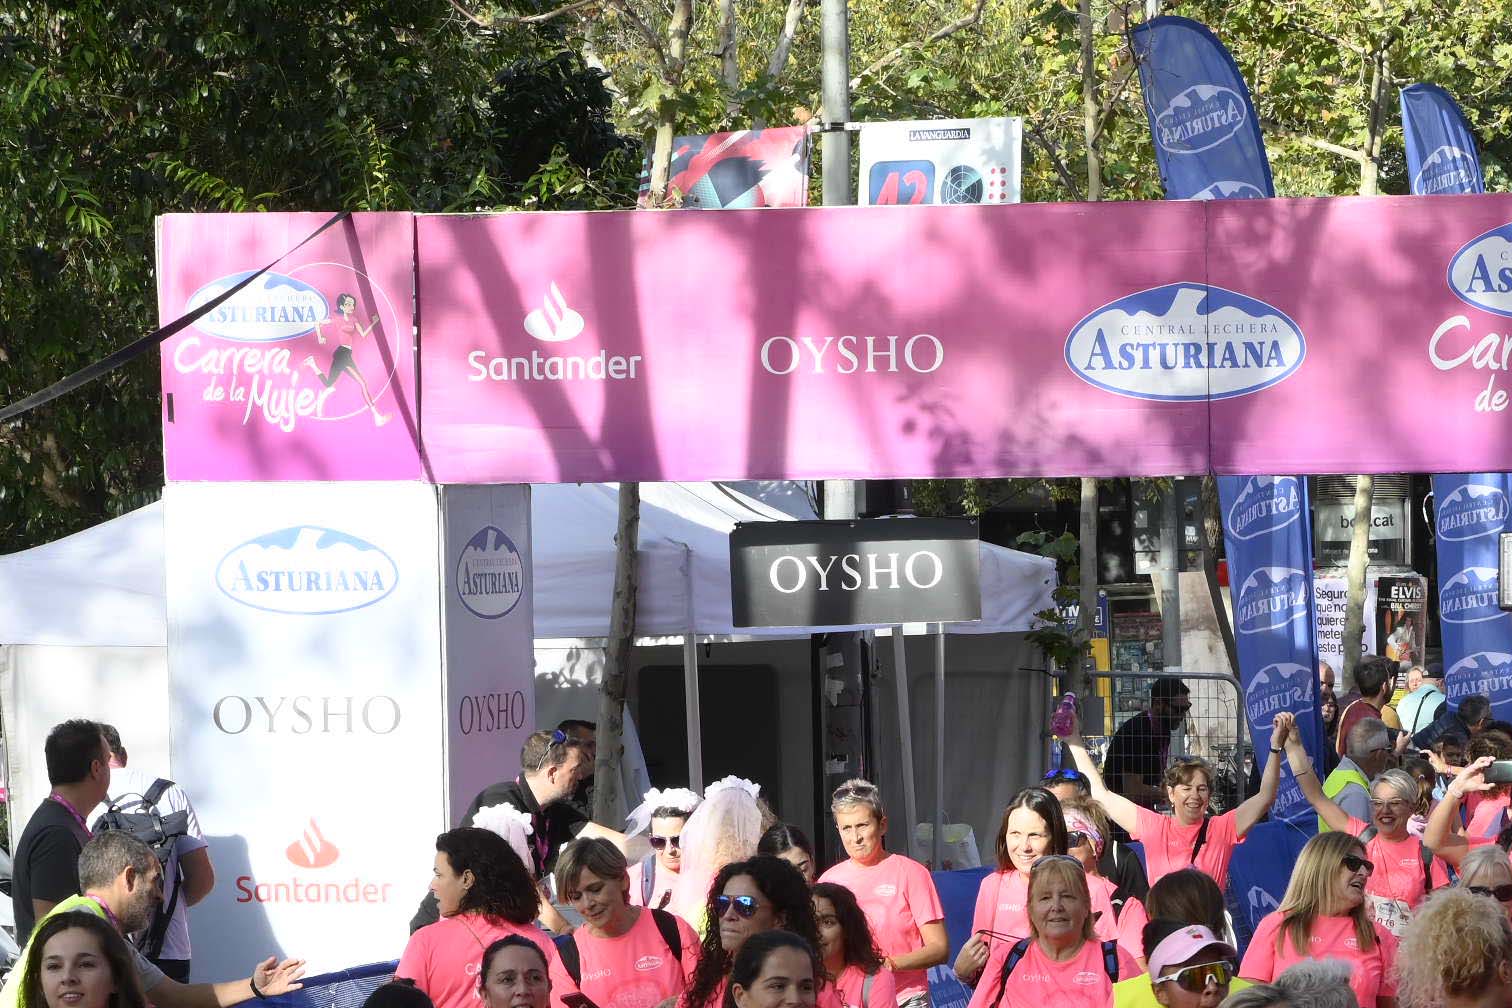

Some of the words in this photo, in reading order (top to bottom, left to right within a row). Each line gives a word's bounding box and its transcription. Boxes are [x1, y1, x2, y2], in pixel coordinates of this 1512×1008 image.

[200, 304, 318, 324] STURIANA
[1121, 324, 1196, 336] CENTRAL
[173, 338, 292, 375] Carrera
[468, 350, 641, 381] Santander
[760, 334, 944, 376] OYSHO
[1084, 327, 1287, 372] ASTURIANA
[204, 375, 225, 401] de
[229, 375, 246, 401] la
[243, 374, 337, 433] Mujer
[1475, 375, 1509, 413] de
[1341, 514, 1395, 529] b.cat
[232, 560, 386, 593] ASTURIANA
[462, 560, 520, 597] ASTURIANA
[769, 551, 944, 594] OYSHO
[1391, 586, 1421, 599] ELVIS
[213, 695, 400, 734] OYSHO
[460, 691, 525, 735] OYSHO
[236, 876, 392, 903] Santander
